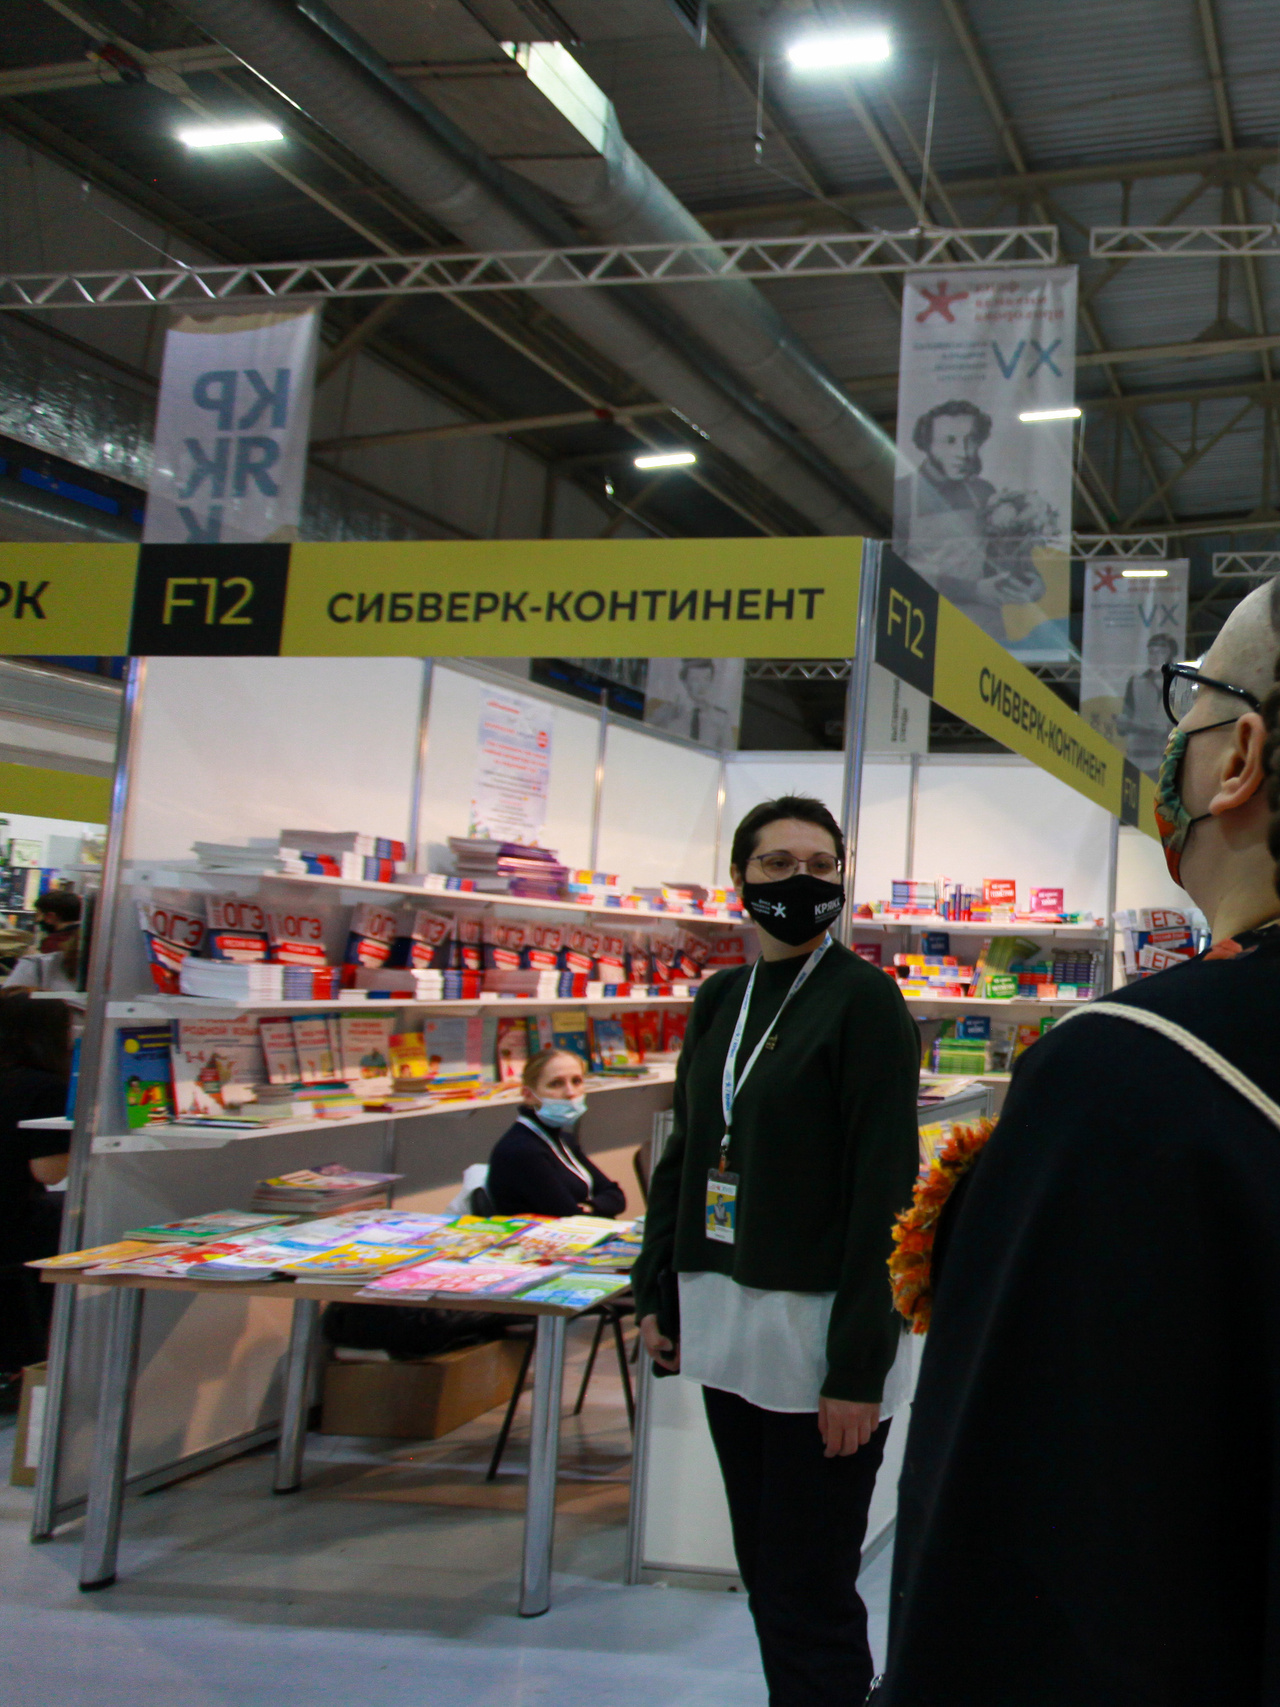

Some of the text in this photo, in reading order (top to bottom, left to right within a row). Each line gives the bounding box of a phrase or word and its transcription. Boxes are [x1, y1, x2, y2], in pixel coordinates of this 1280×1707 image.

[163, 576, 254, 625] F12
[328, 589, 826, 625] СИБВЕРК-КОНТИНЕНТ
[888, 588, 926, 660] F12
[979, 666, 1108, 784] СИБВЕРК-КОНТИНЕНТ
[153, 910, 205, 946] ОГЭ
[223, 902, 265, 930] ОГЭ
[284, 915, 323, 940] ОГЭ
[1151, 910, 1187, 928] ЕГЭ
[1151, 952, 1184, 970] ЕГ
